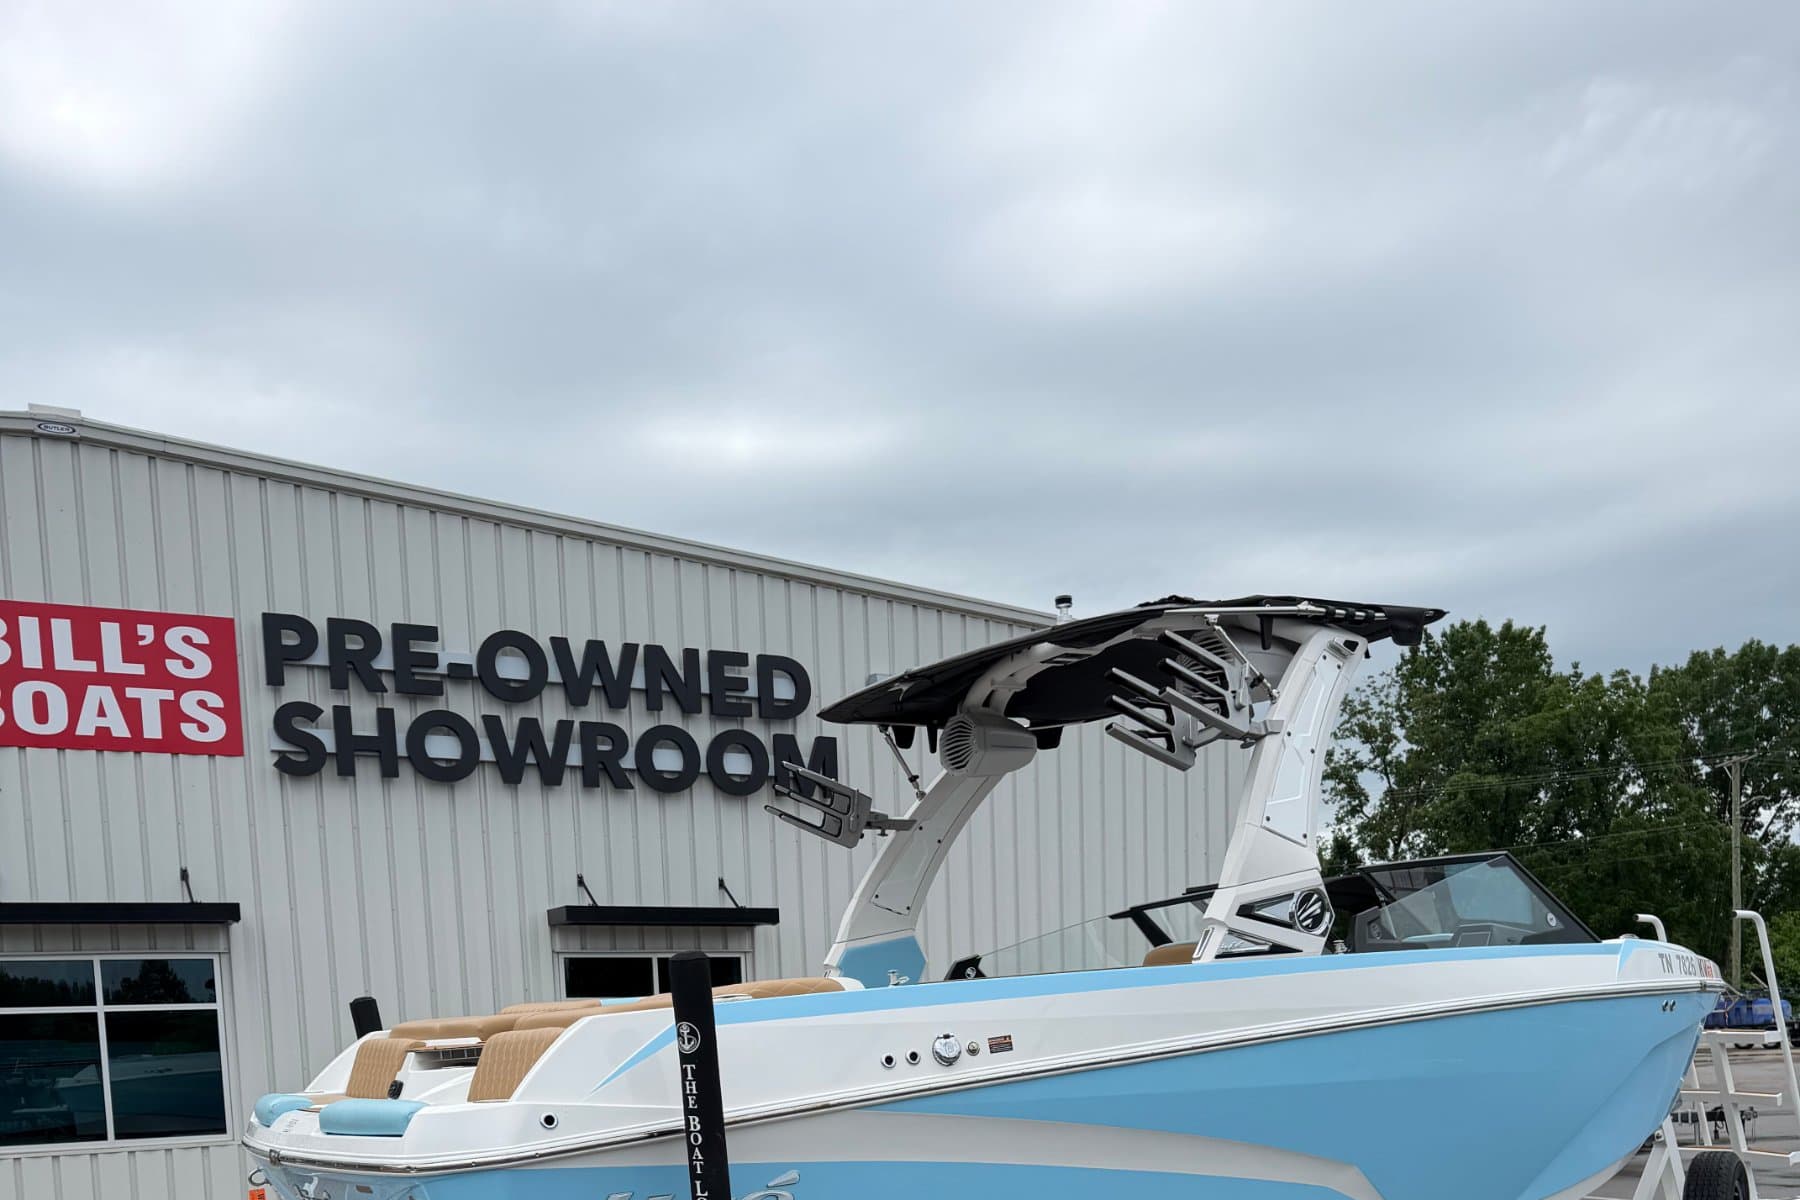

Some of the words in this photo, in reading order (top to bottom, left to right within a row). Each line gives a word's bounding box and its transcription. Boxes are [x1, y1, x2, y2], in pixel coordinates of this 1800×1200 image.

[0, 615, 212, 679] ILL'S
[262, 612, 811, 720] PRE-OWNED
[0, 680, 227, 742] OATS
[273, 701, 838, 798] SHOWROOM
[1658, 953, 1673, 974] TN
[683, 1064, 698, 1109] THE
[688, 1115, 704, 1174] BOAT
